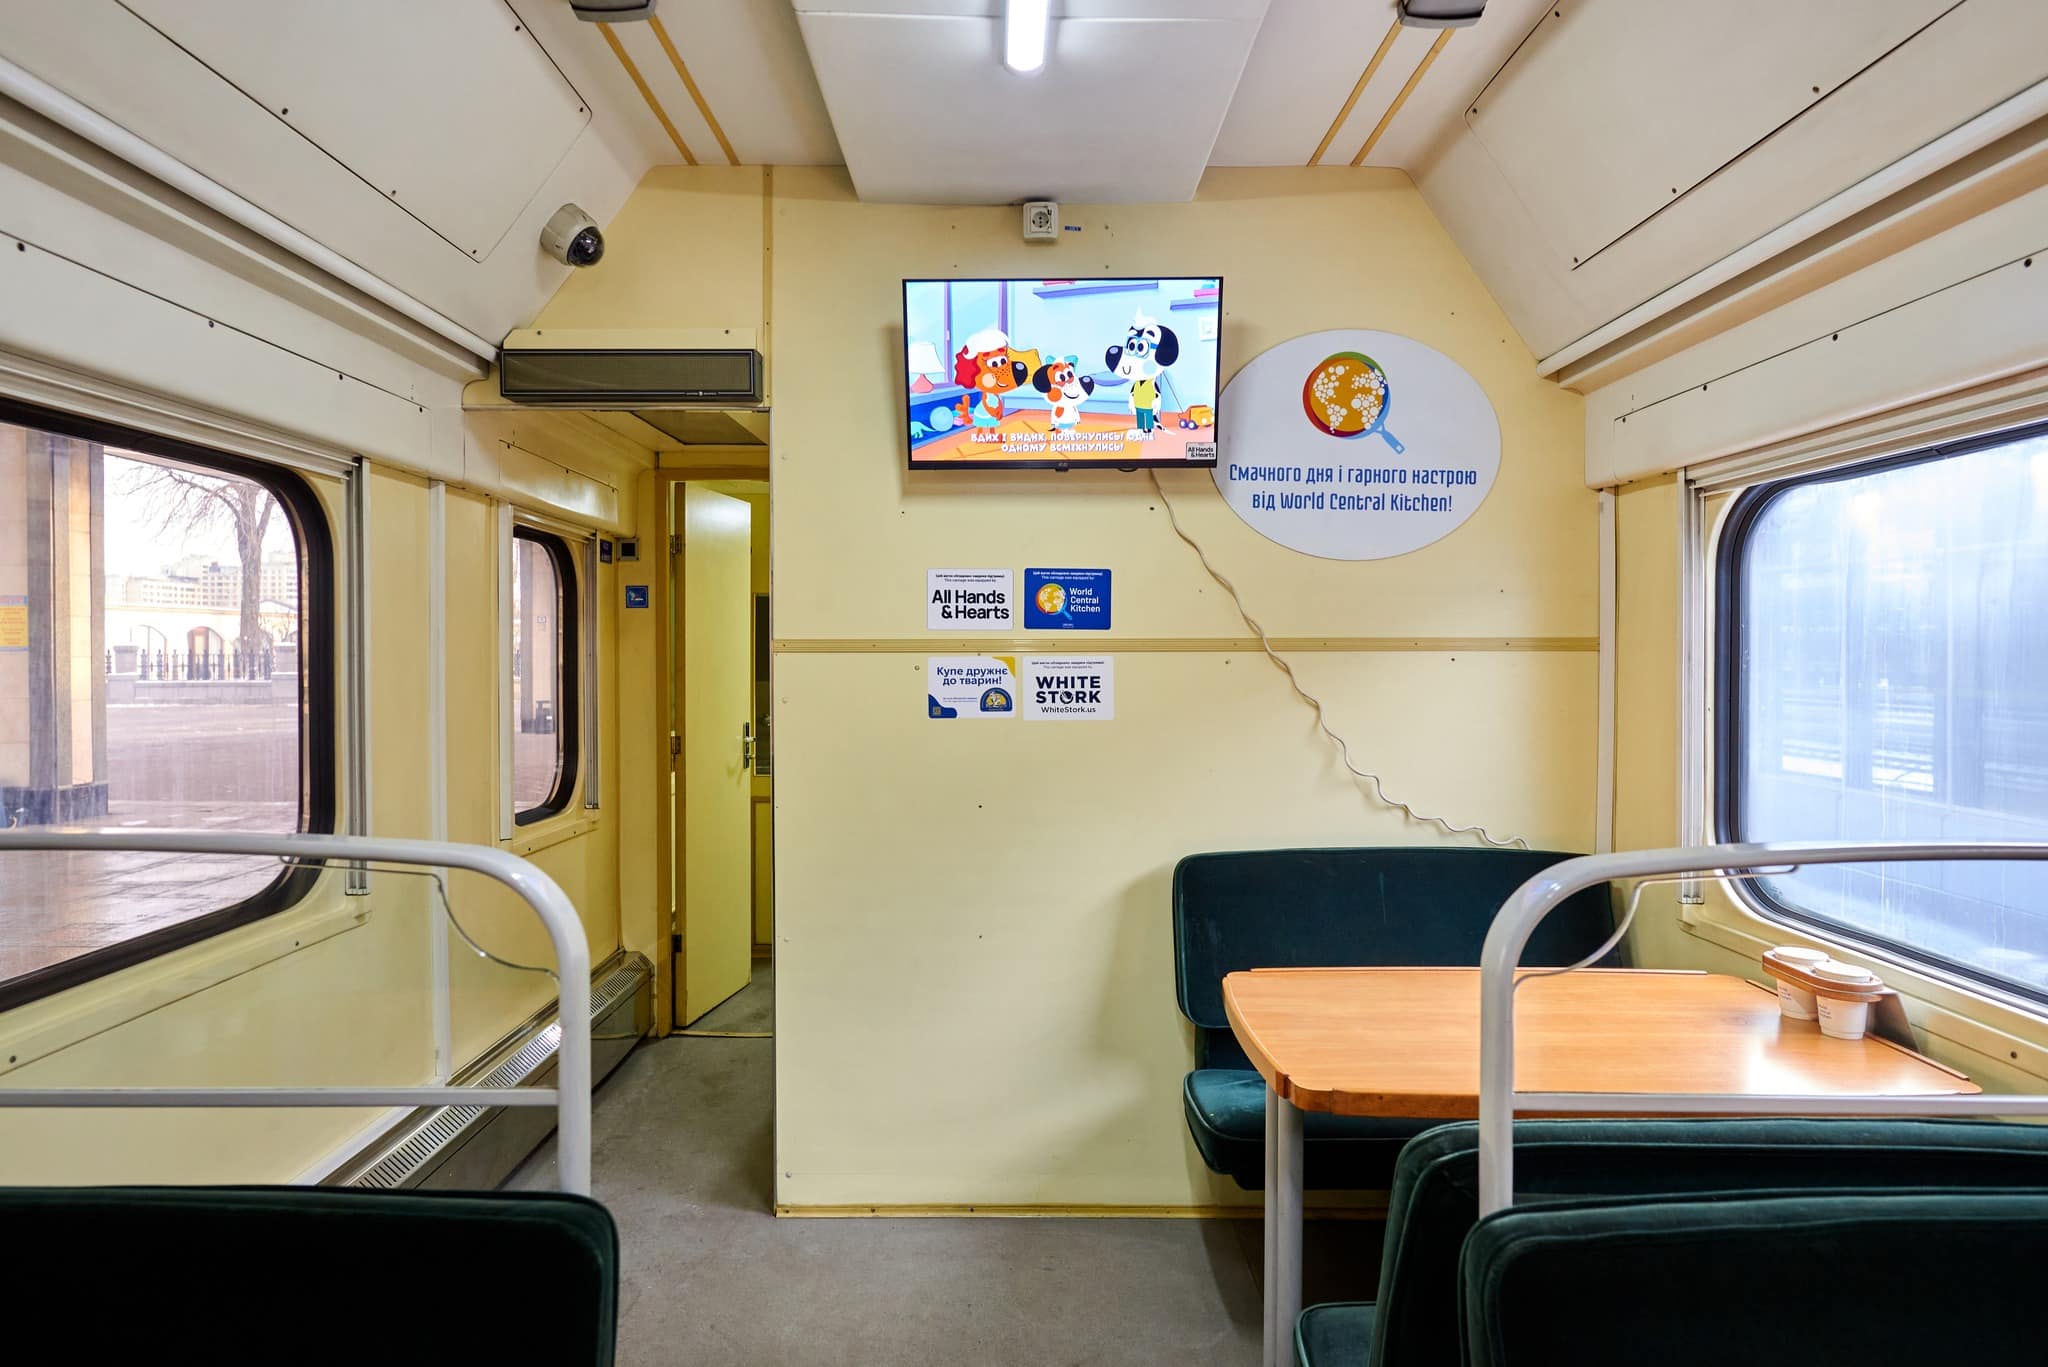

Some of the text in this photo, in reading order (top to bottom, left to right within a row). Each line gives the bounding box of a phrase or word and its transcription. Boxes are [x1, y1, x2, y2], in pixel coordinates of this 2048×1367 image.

[971, 433, 999, 442] ВДИХ
[1001, 443, 1046, 452] ОДНОМУ
[1230, 464, 1477, 487] Смачного дня і гарного настрою
[1252, 492, 1452, 512] від World Central Kitchen!
[932, 590, 1005, 604] All Hands
[1069, 587, 1093, 596] World
[1070, 596, 1099, 604] Central
[941, 605, 1009, 619] & Hearts
[1070, 604, 1101, 612] Kitchen
[937, 667, 1008, 679] Купе дружнє
[943, 677, 1002, 687] до тварин!
[1036, 676, 1101, 689] WHITE
[1036, 690, 1101, 704] STORK
